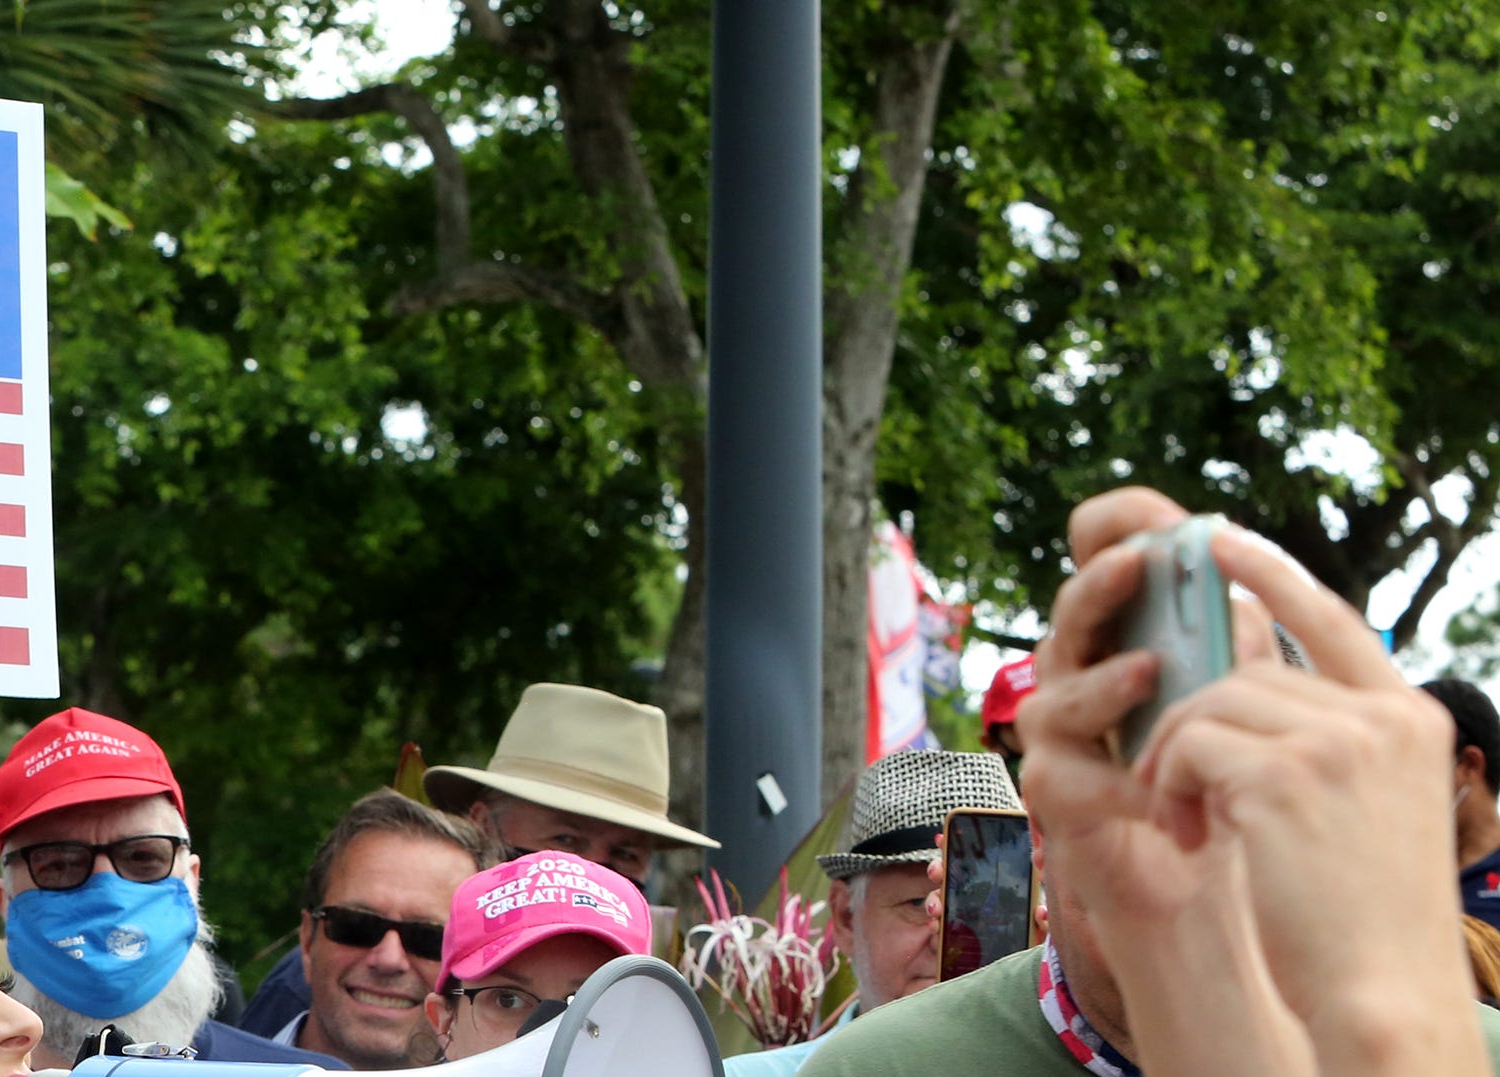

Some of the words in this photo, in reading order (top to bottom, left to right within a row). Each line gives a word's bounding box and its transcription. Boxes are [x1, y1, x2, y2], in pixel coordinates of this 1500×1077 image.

[23, 737, 62, 768] MAKE
[65, 730, 140, 753] AMERICA
[25, 746, 75, 778] GREAT
[77, 743, 131, 758] AGAIN
[526, 859, 586, 877] 2020
[476, 877, 533, 910] KEEP
[535, 873, 633, 919] AMERICA
[484, 888, 568, 919] GREAT!
